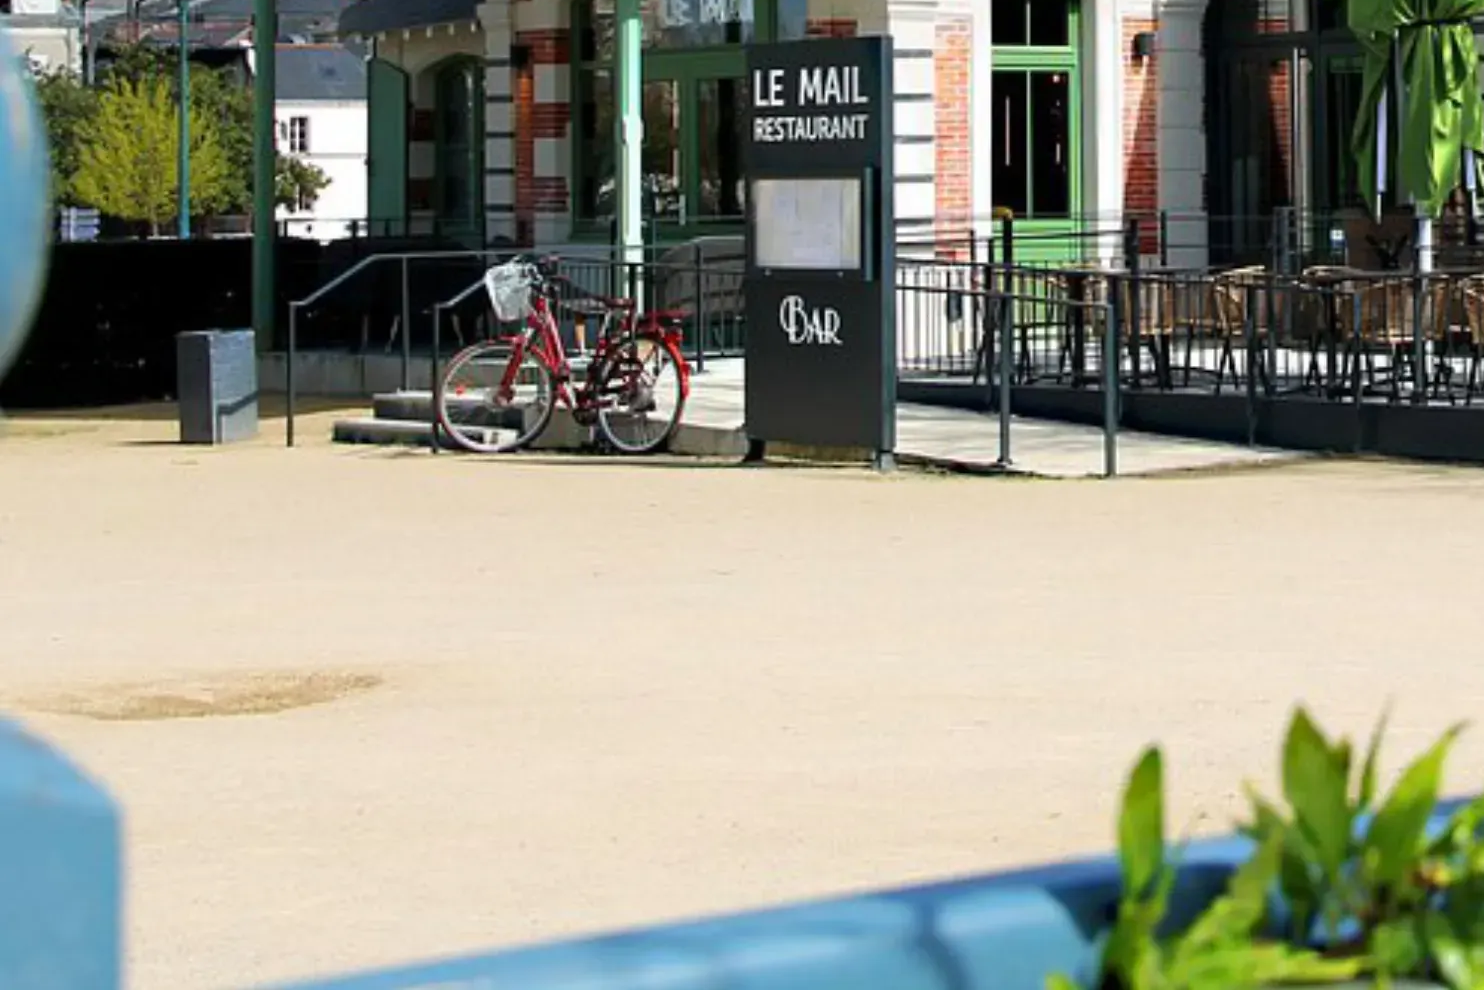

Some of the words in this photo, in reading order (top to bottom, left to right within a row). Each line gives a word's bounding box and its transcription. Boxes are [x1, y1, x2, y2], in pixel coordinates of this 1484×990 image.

[754, 69, 785, 106] LE
[799, 66, 869, 106] MAIL
[753, 113, 869, 142] RESTAURANT
[780, 295, 843, 345] BAR
